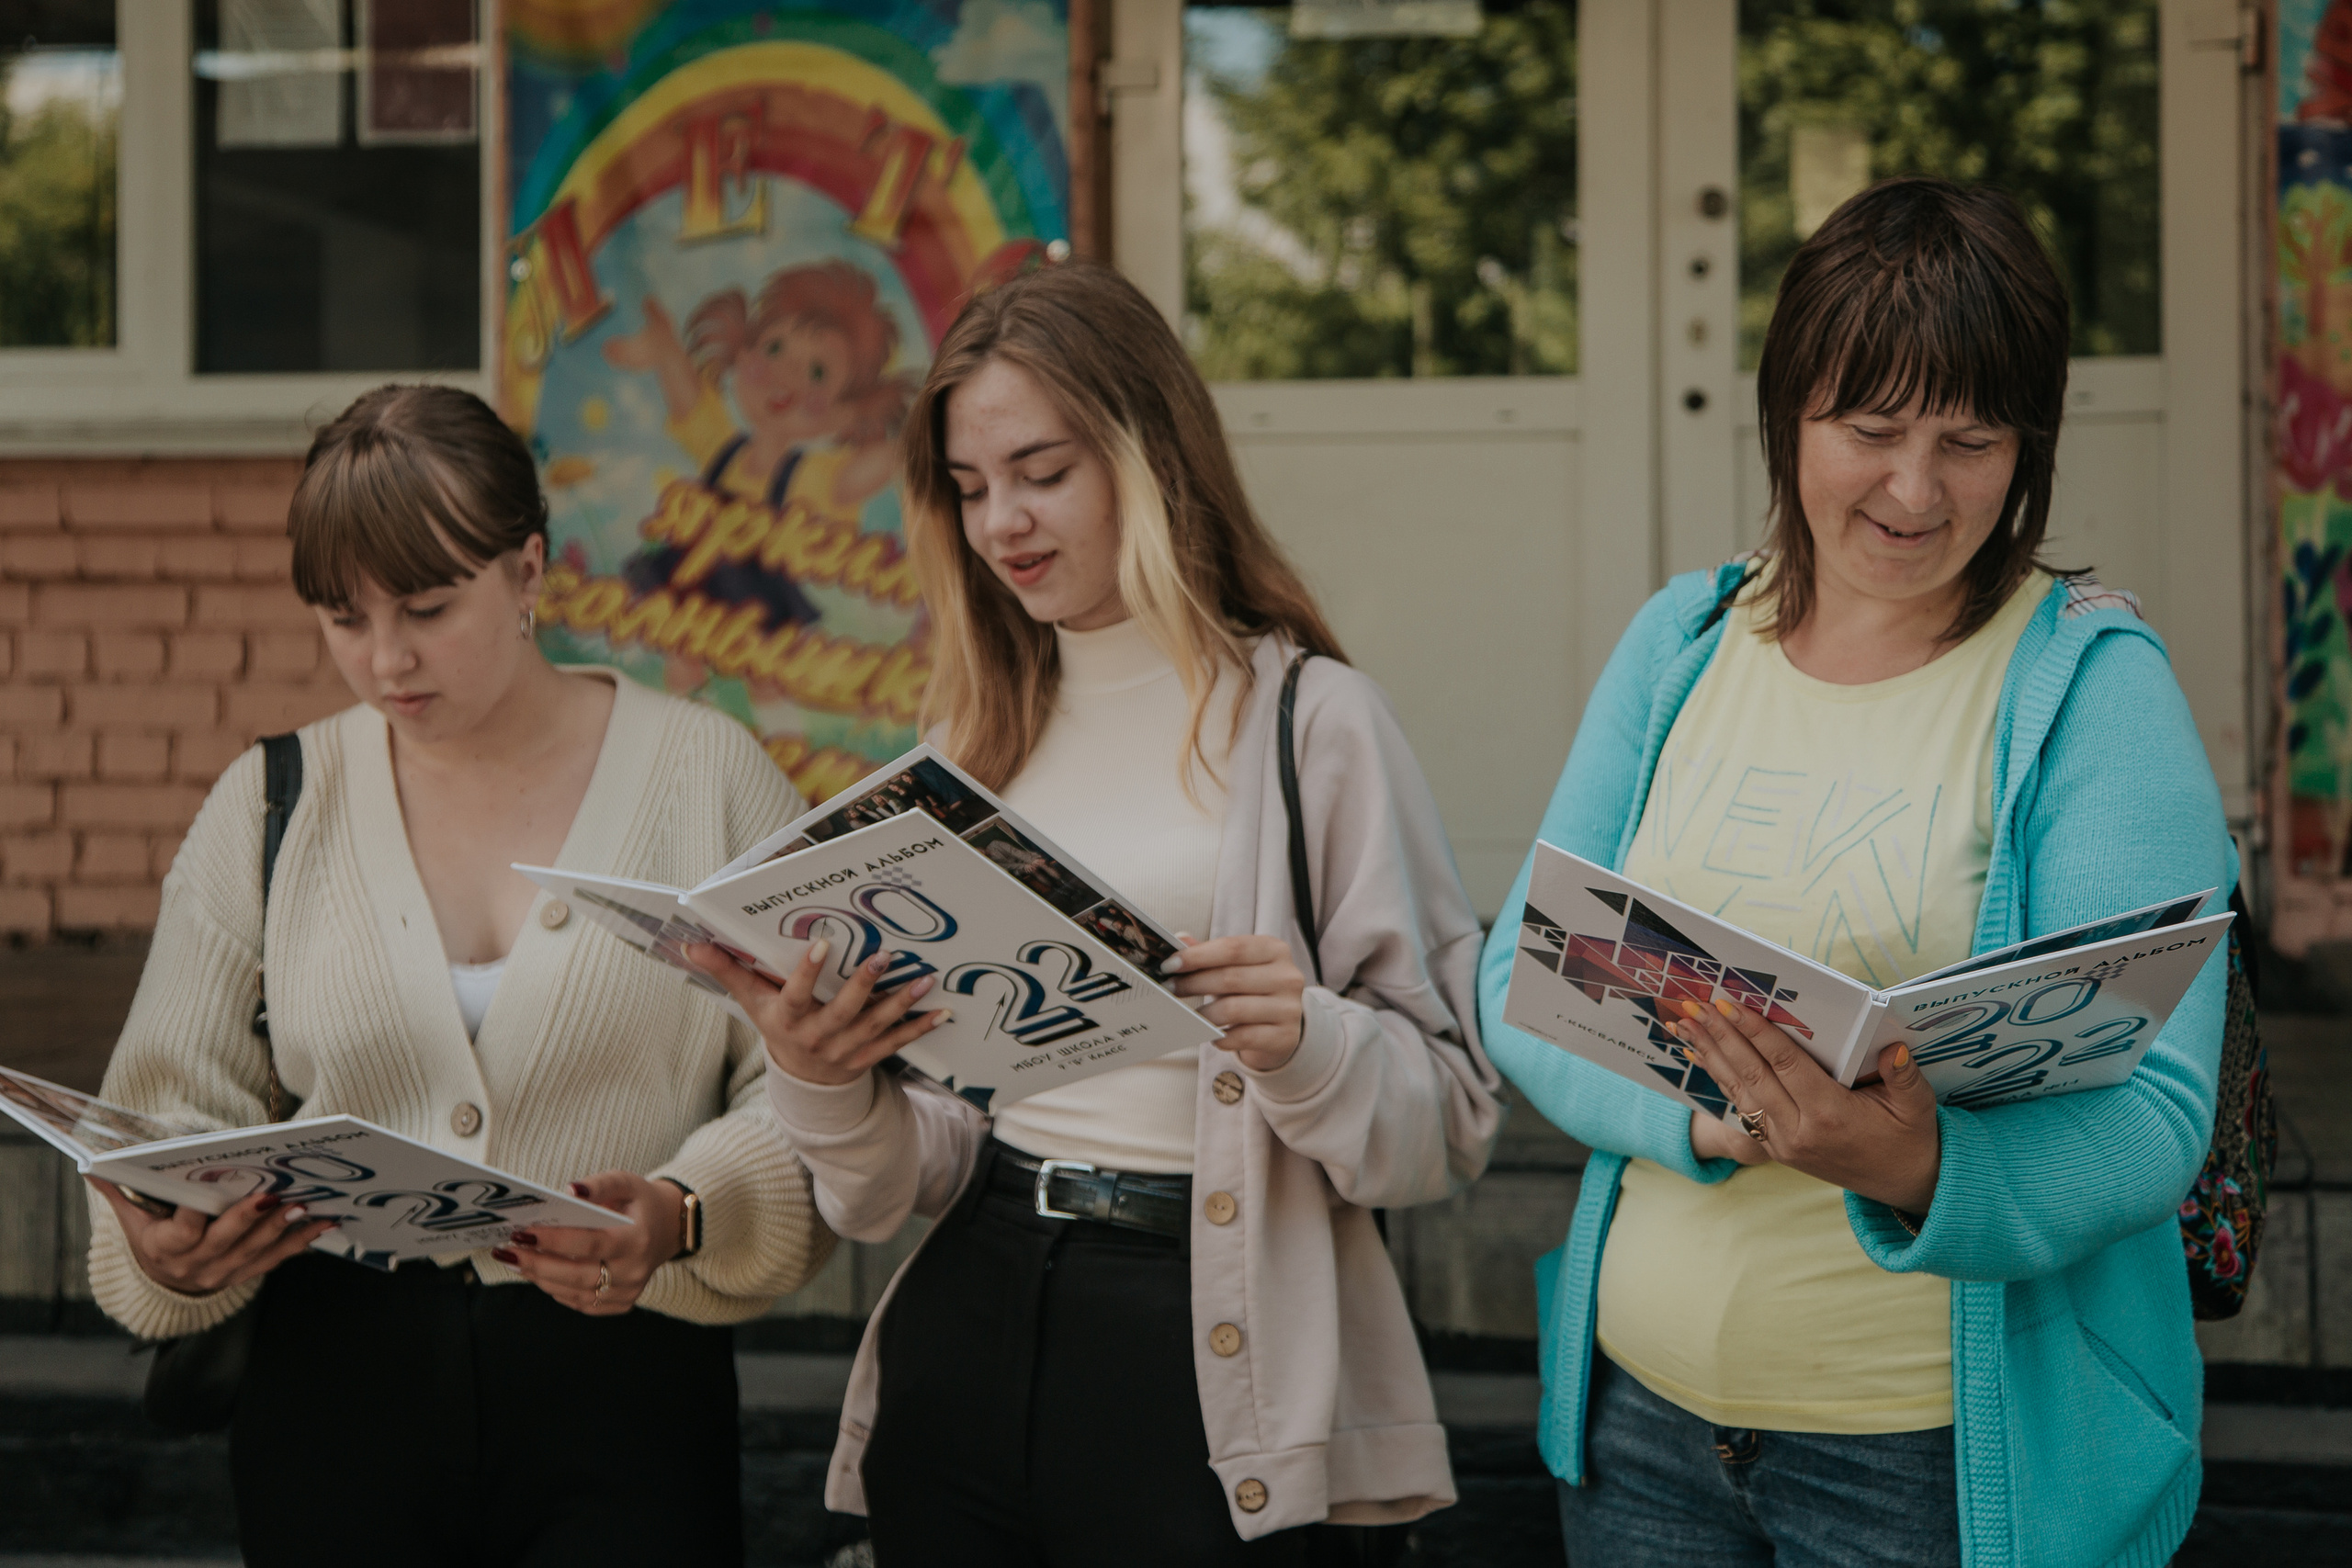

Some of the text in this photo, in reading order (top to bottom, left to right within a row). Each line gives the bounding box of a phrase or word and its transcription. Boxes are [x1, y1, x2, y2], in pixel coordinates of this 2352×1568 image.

[536, 568, 930, 721] солнышк
[741, 837, 944, 917] ВЫПУСКНОЙ АЛЬБОМ
[1913, 936, 2208, 1012] ВЫПУСКНОЙ АЛЬБОМ
[1010, 1053, 1052, 1073] МБОУ
[1057, 1035, 1114, 1055] ШКОЛА
[1088, 1043, 1127, 1062] КЛАСС
